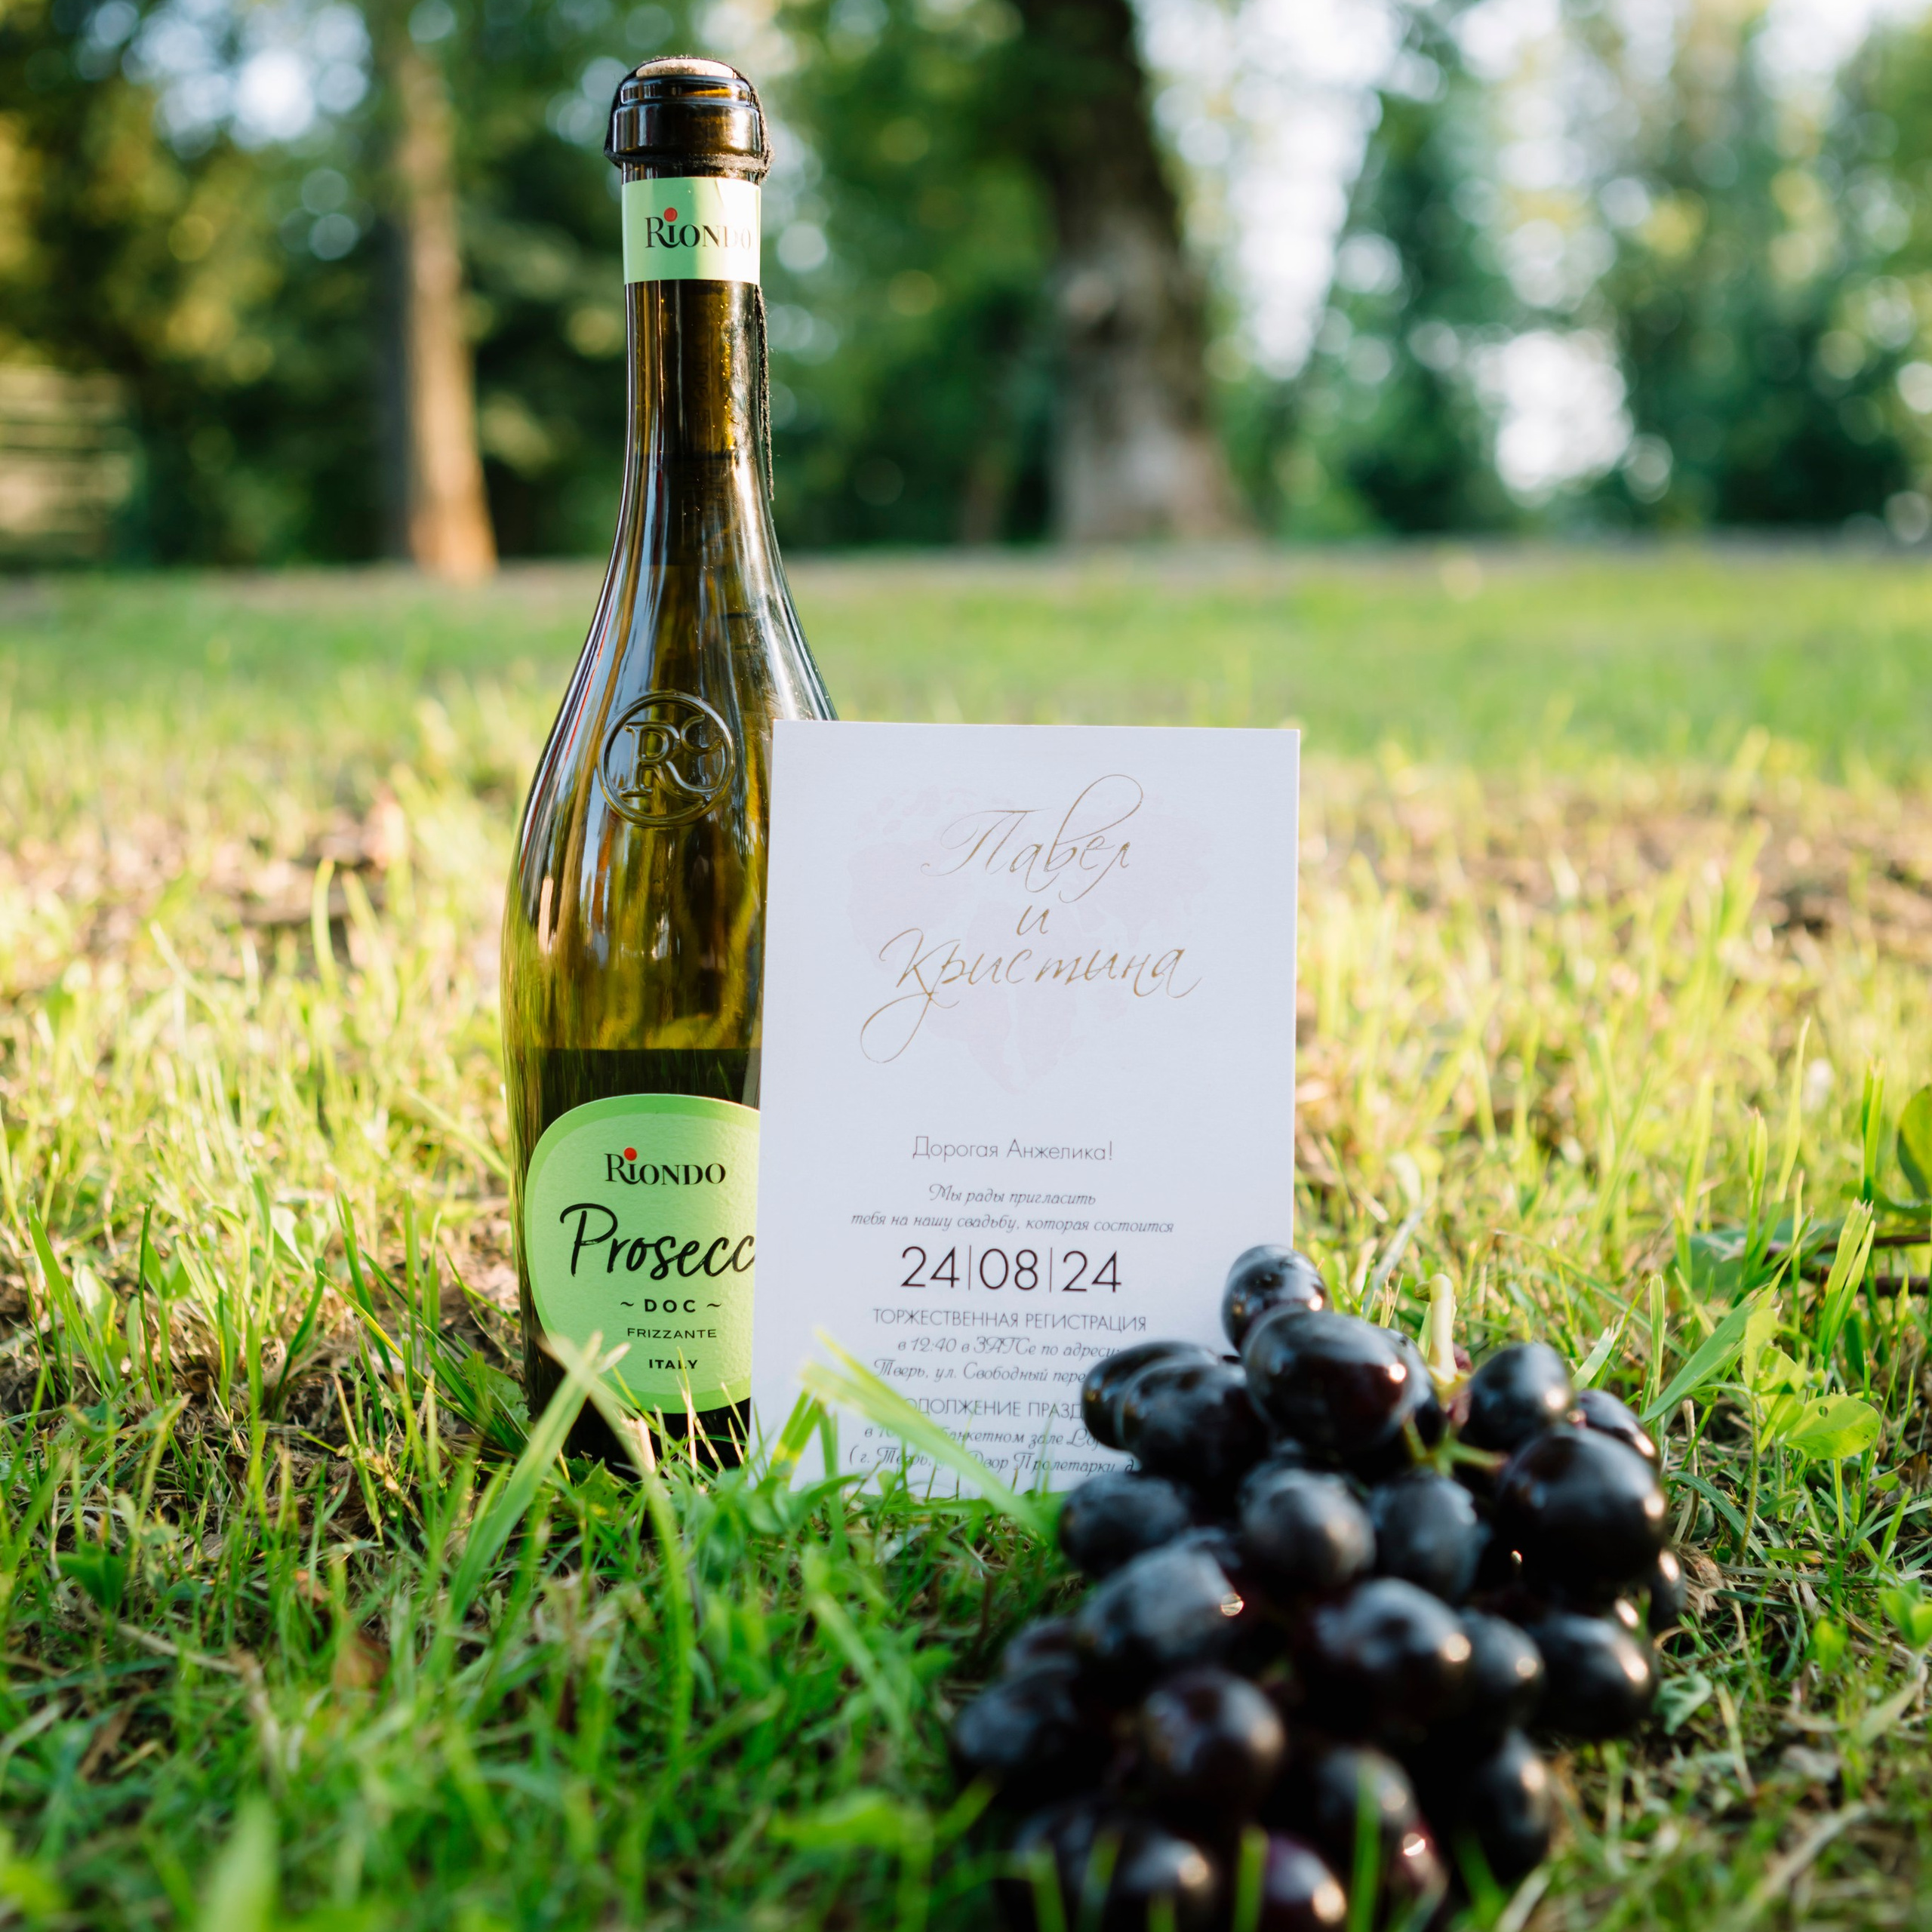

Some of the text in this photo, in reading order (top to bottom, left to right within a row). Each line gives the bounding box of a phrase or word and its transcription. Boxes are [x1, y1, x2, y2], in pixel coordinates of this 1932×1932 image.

[920, 774, 1143, 903] Павел
[1017, 905, 1050, 936] и
[860, 928, 1202, 1063] Кристина
[912, 1136, 1113, 1162] Дорогая Анжелика!
[929, 1183, 1096, 1208] Мы рады пригласить
[851, 1211, 1174, 1235] тебя на нашу свадьбу, которая состоится
[559, 1203, 755, 1281] Prosecc
[645, 1299, 696, 1312] DOC
[627, 1327, 717, 1339] FRIZZANTE
[873, 1309, 1146, 1333] ТОРЖЕСТВЕННАЯ РЕГИСТРАЦИЯ
[897, 1341, 906, 1351] в
[911, 1337, 957, 1352] 12:40
[961, 1343, 970, 1352] в
[974, 1336, 1036, 1355] ЗАГСе
[1041, 1345, 1059, 1355] по
[648, 1359, 698, 1370] ITALY
[874, 1358, 1086, 1386] Тверь, ул. Свободный пере
[904, 1398, 1082, 1420] ОДОЛЖЕНИЕ ПРАЗД
[1029, 1432, 1063, 1449] зале
